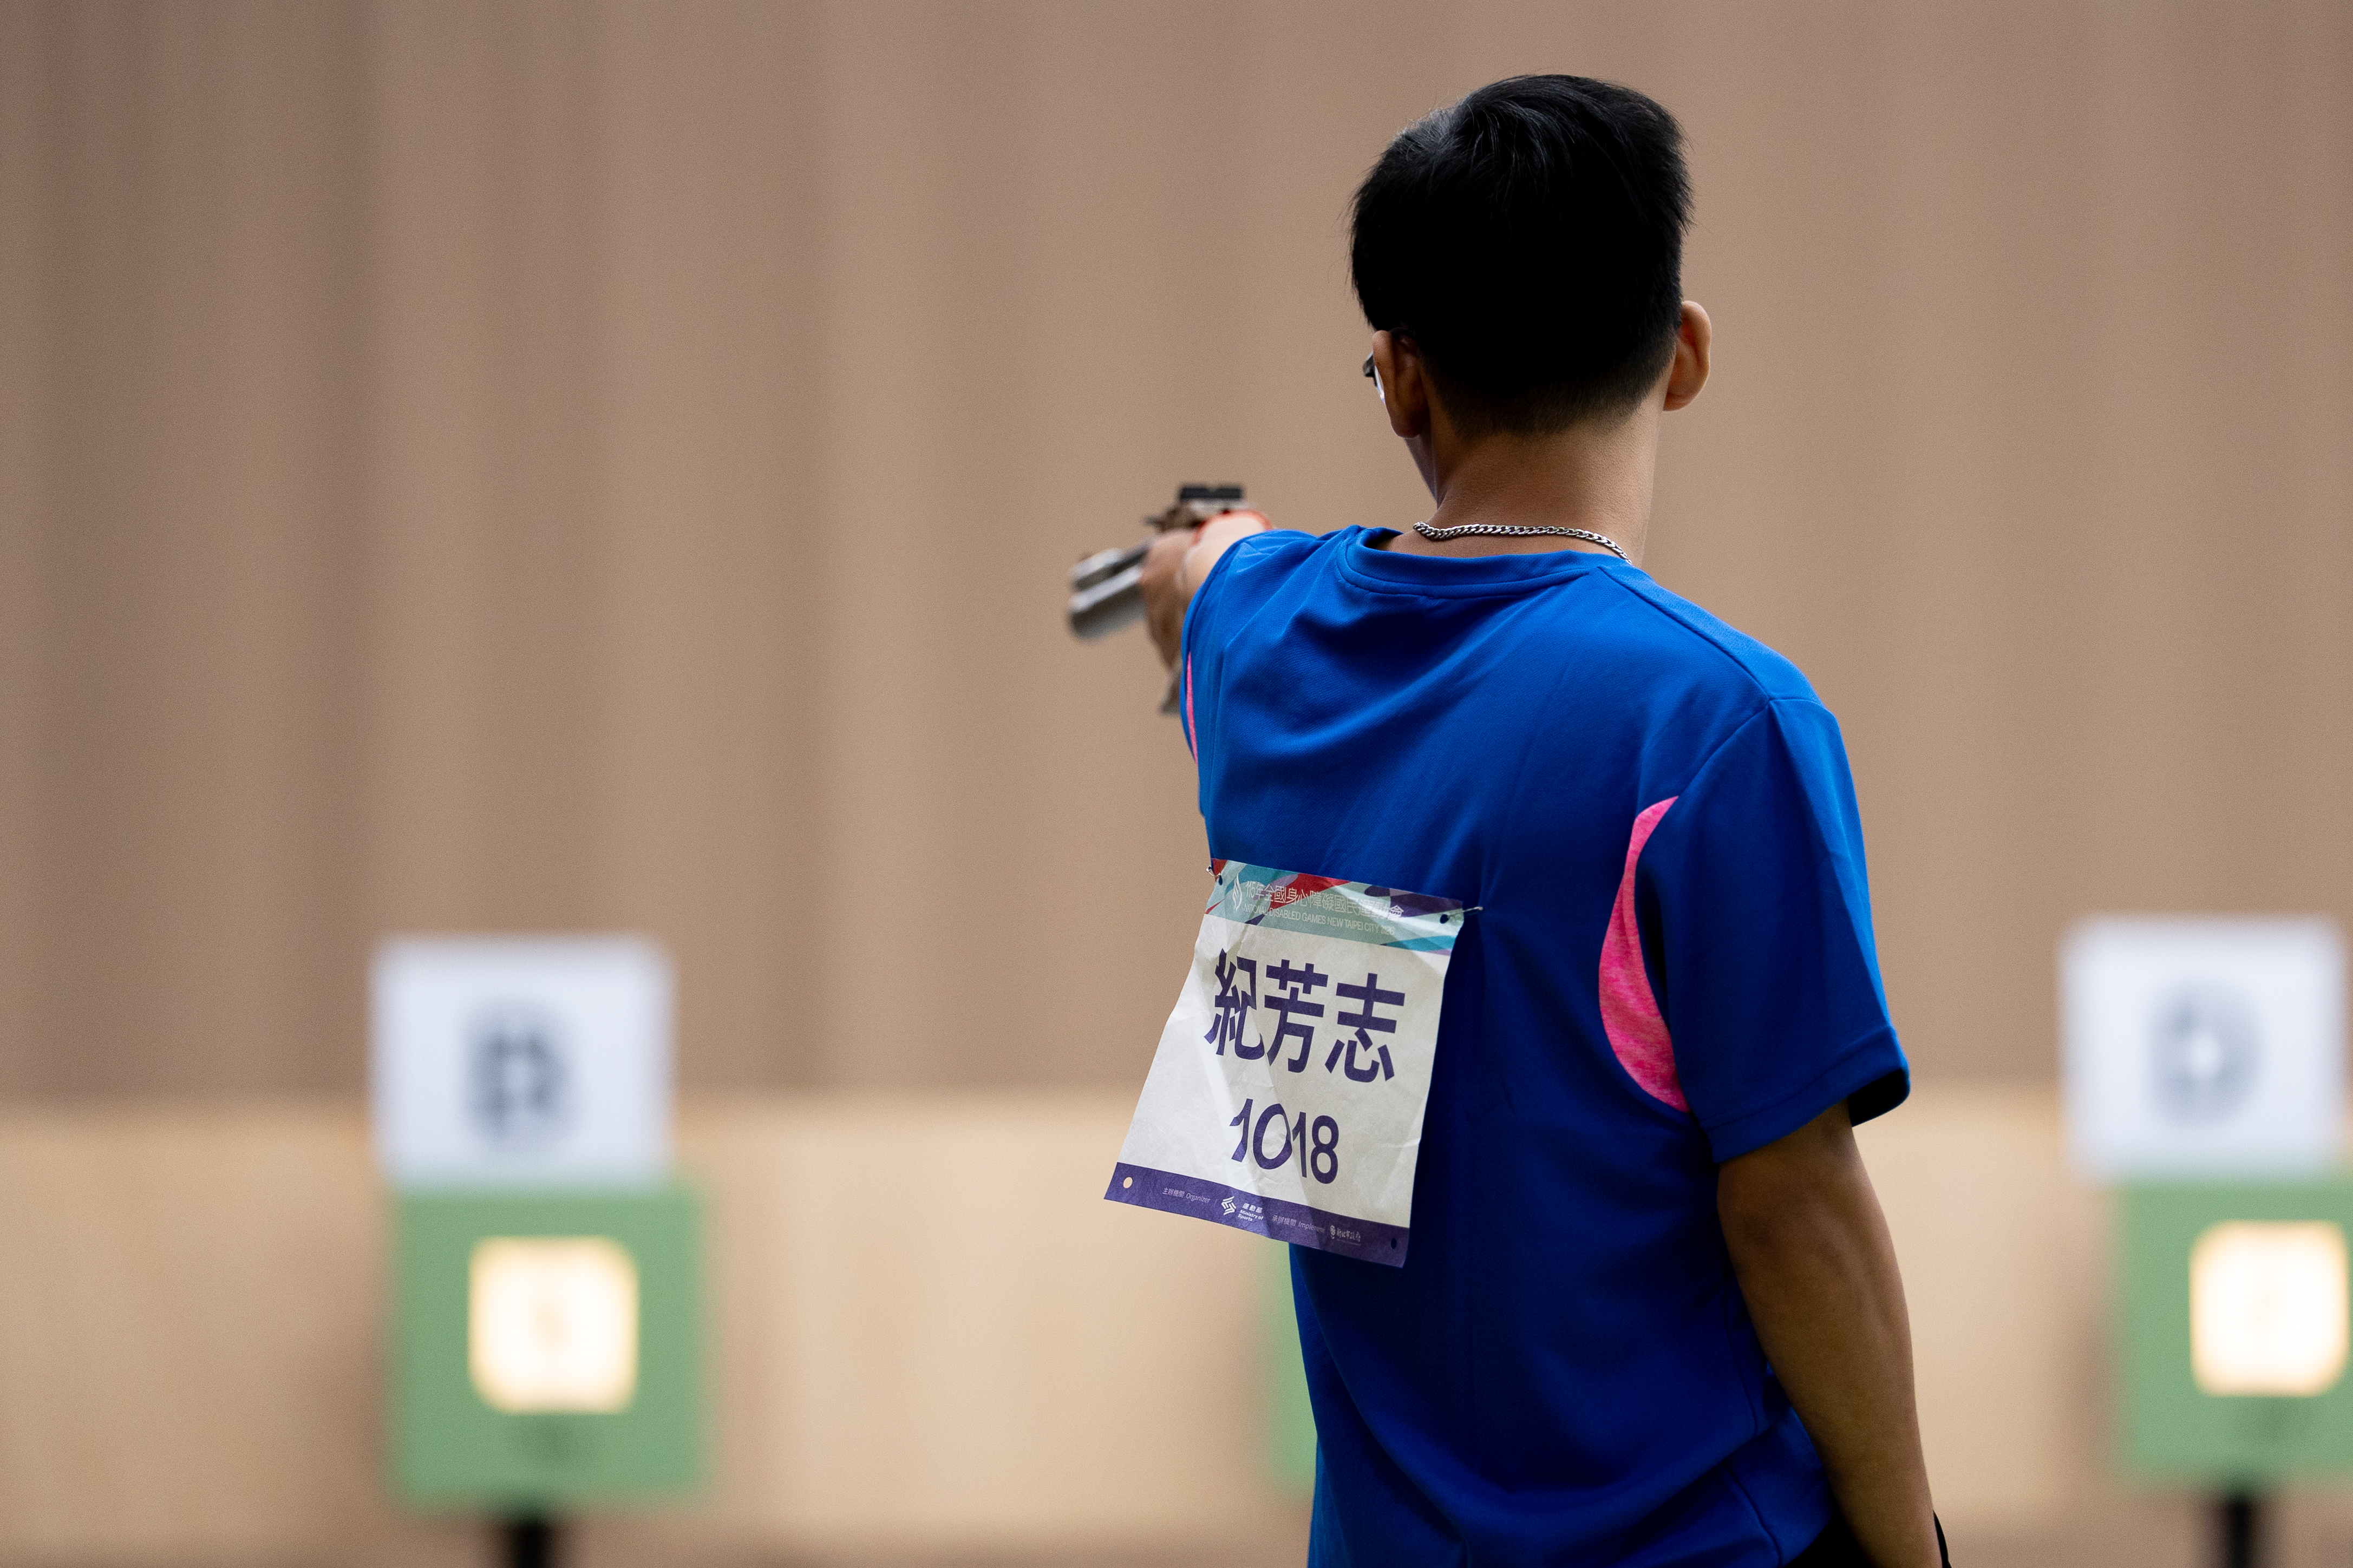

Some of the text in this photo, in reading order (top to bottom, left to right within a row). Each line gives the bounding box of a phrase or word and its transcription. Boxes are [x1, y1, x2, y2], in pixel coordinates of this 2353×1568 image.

[1269, 907, 1300, 921] DISABLED
[1302, 912, 1326, 925] GAMES
[1327, 916, 1343, 928] NEW
[1345, 919, 1363, 931] TAIPEI
[1364, 922, 1379, 933] CITY
[1204, 948, 1406, 1083] 紀芳志
[1229, 1098, 1339, 1185] 1018
[1186, 1192, 1211, 1203] Organizer
[1239, 1209, 1258, 1219] Ministry
[1242, 1202, 1263, 1214] 運動部
[1237, 1213, 1253, 1222] Sports
